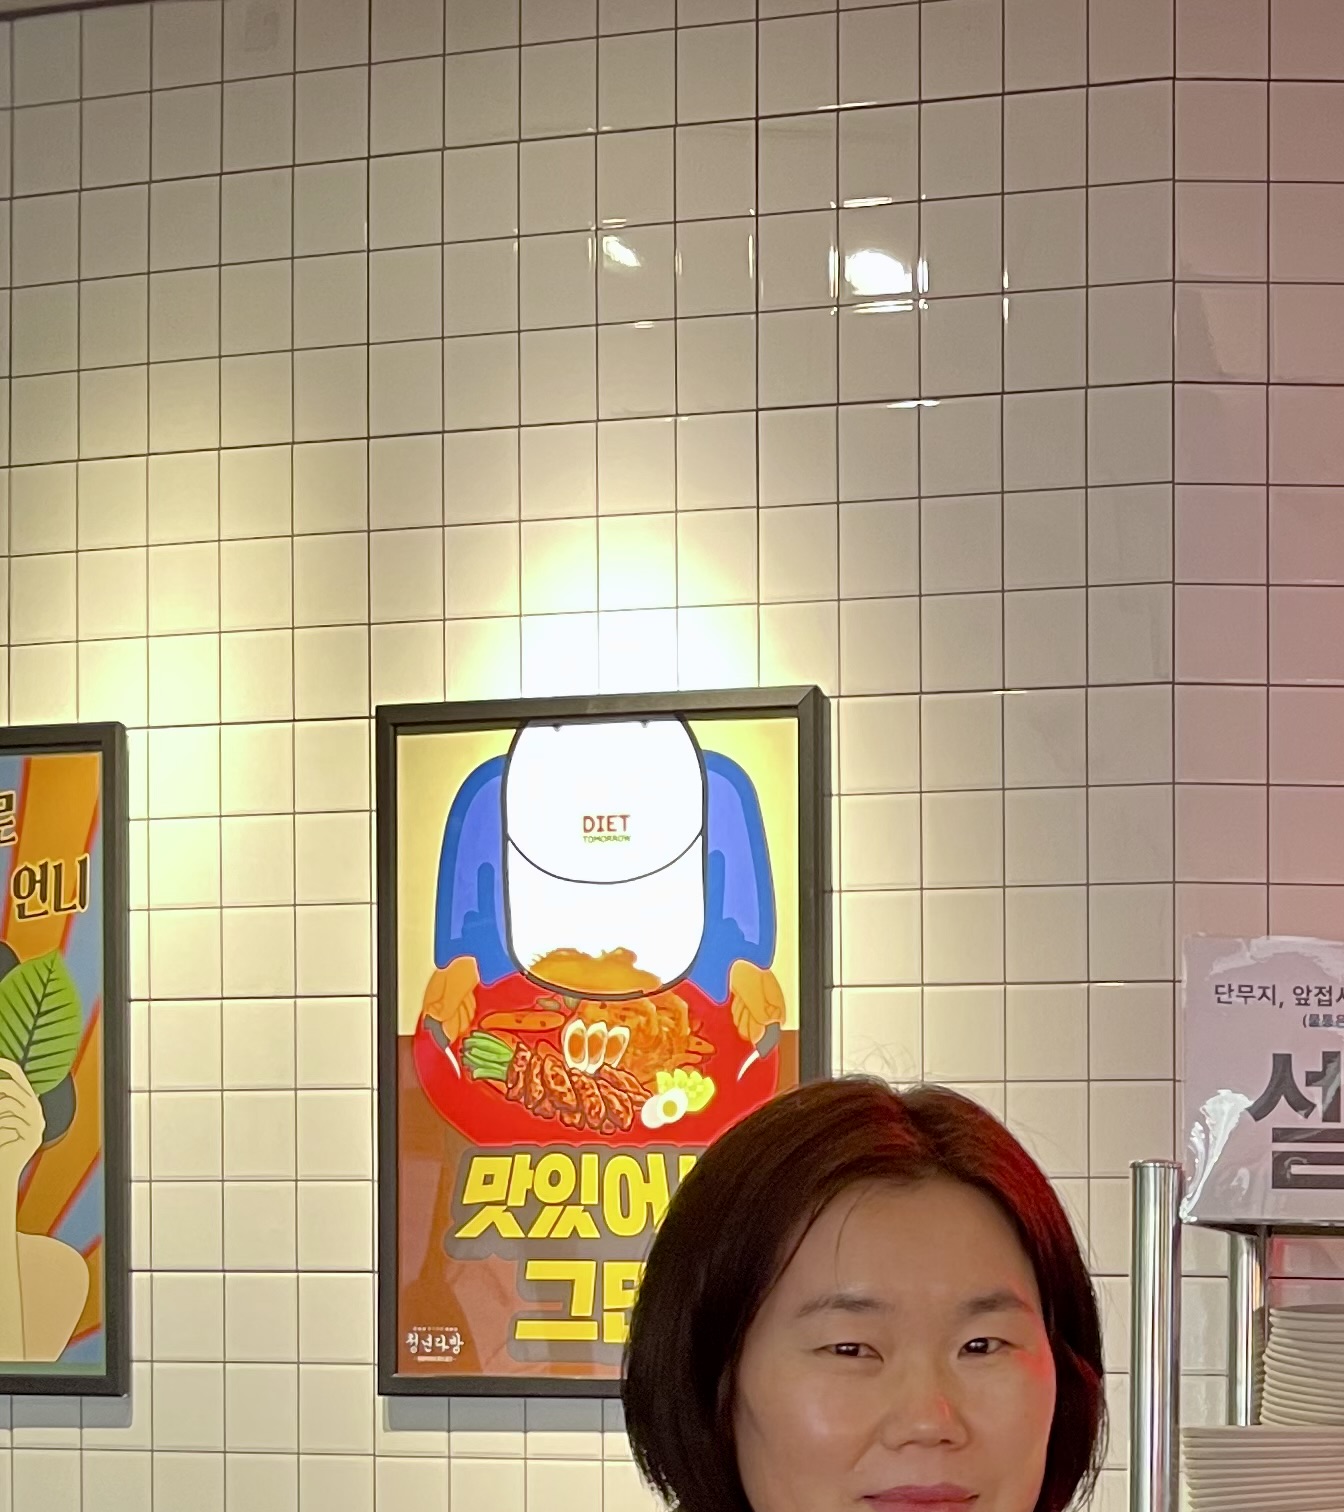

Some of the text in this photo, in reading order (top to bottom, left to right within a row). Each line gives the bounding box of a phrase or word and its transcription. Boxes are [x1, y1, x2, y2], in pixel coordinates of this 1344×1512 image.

[583, 814, 630, 833] DIET
[11, 853, 90, 922] 언니
[1214, 983, 1285, 1009] 단무지,
[454, 1152, 699, 1239] 맛있어
[405, 1332, 465, 1355] 청년다방
